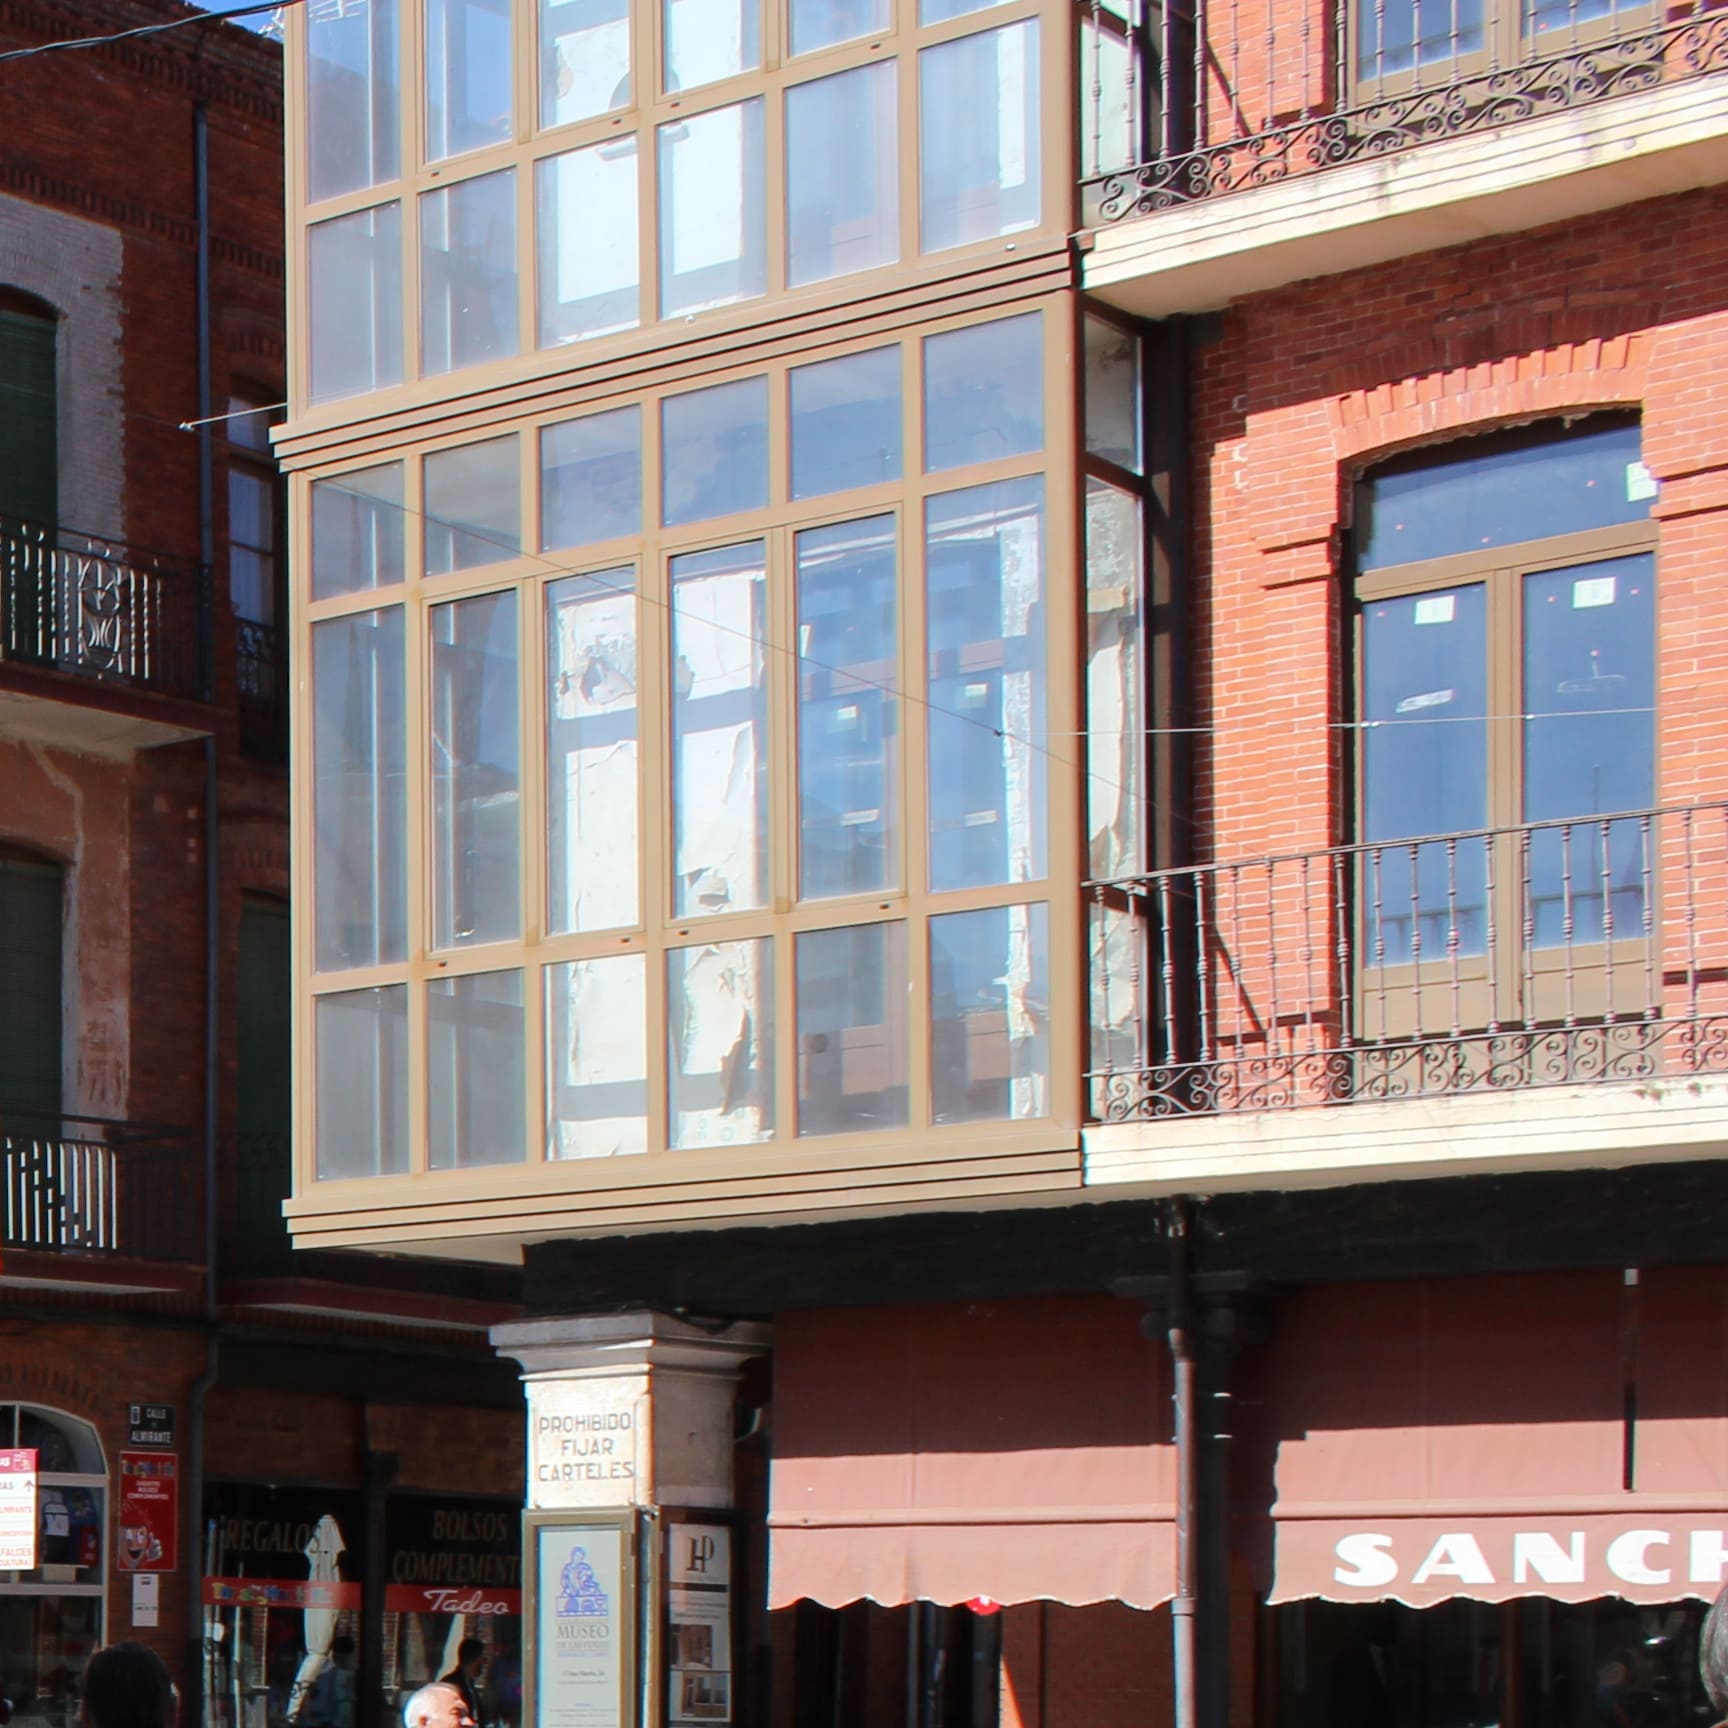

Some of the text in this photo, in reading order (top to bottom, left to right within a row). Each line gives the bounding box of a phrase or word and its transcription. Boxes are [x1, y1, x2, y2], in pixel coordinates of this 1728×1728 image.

[146, 1408, 167, 1419] CALLE
[538, 1412, 632, 1434] PROHIBIDO
[131, 1431, 172, 1443] ALMIRANTE
[561, 1437, 614, 1457] FIJAR
[538, 1461, 634, 1482] CARTELES
[432, 1510, 510, 1542] BOLSOS
[1, 1548, 32, 1556] FALCES
[423, 1590, 510, 1615] Tadeo
[556, 1625, 610, 1639] MUSEO
